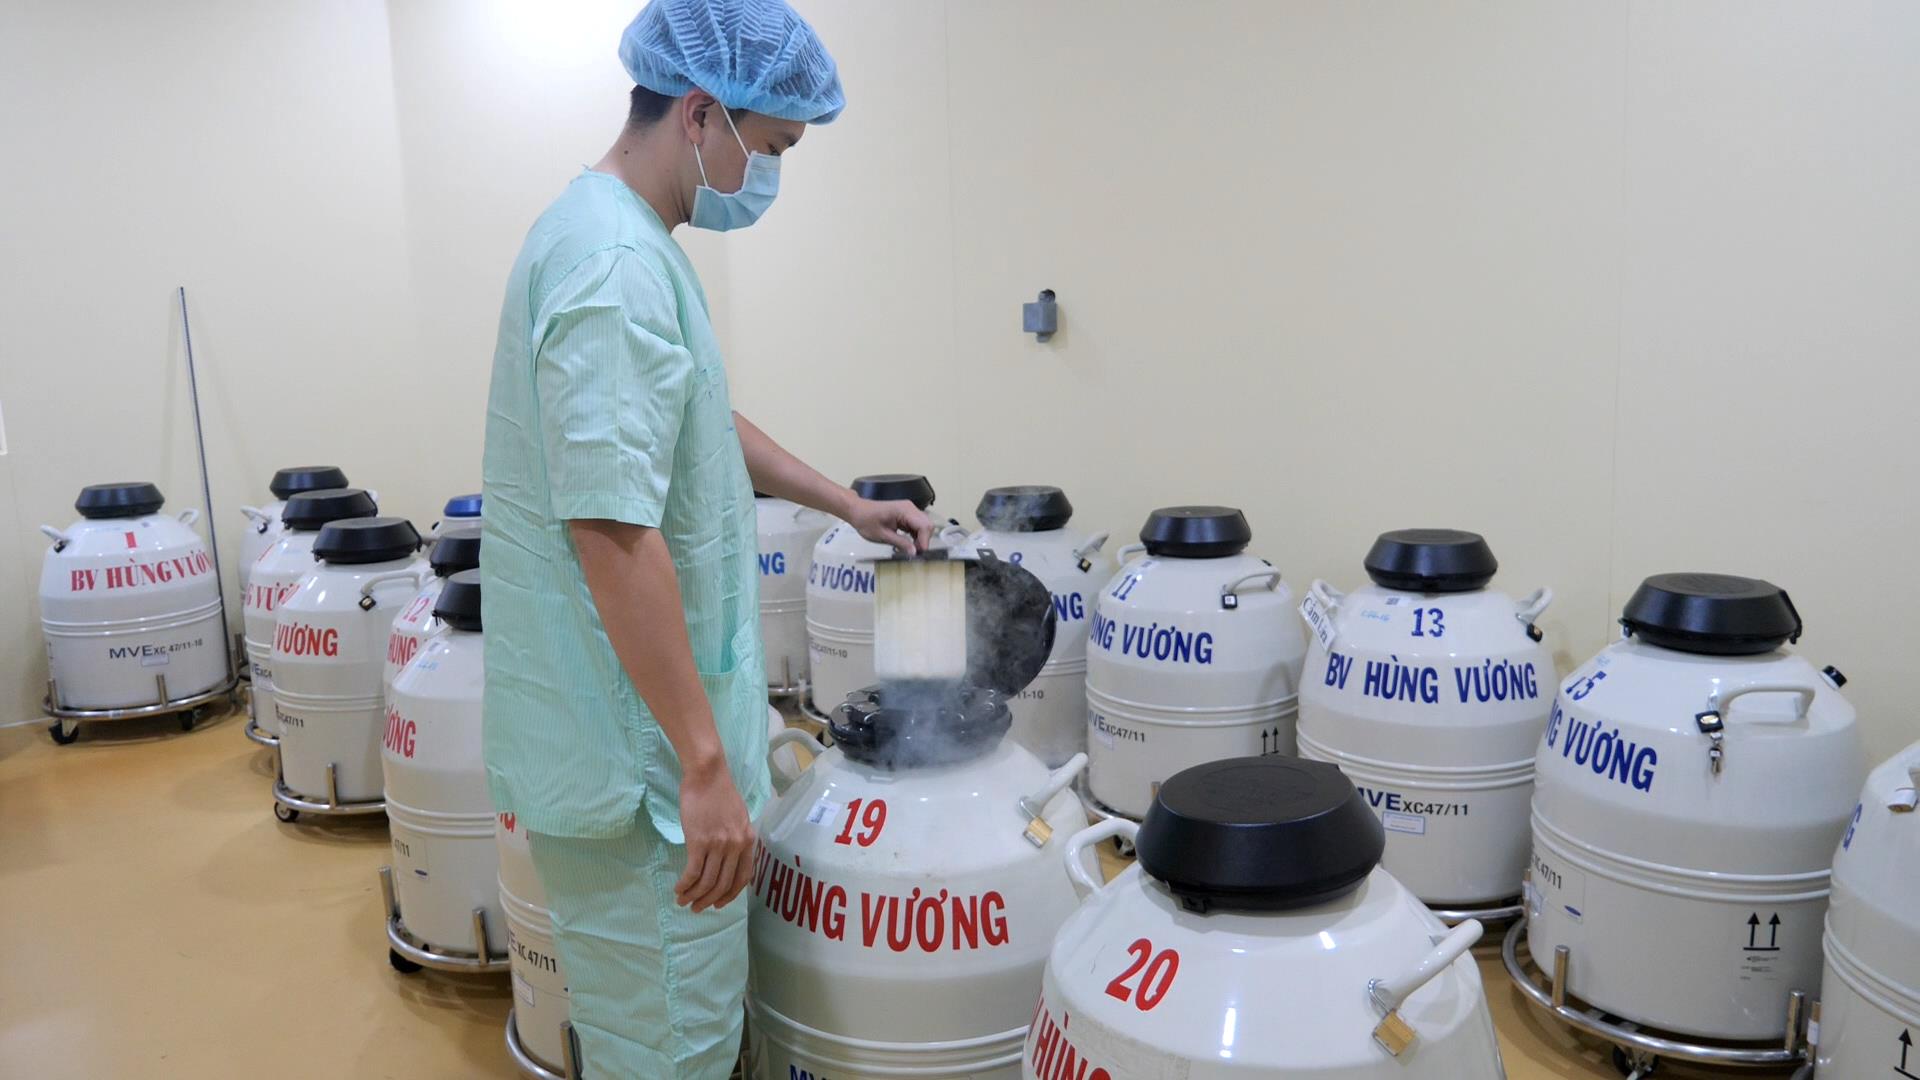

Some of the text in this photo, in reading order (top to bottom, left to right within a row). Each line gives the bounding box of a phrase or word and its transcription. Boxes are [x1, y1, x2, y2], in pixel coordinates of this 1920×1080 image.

[71, 569, 98, 592] BV
[105, 558, 172, 590] HÙNG
[1111, 574, 1138, 601] 11
[276, 621, 340, 657] VƯƠNG
[1122, 622, 1214, 665] VƯƠNG
[1411, 607, 1446, 637] 13
[1324, 652, 1538, 703] BV HÙNG VƯƠNG
[1563, 717, 1658, 794] VƯƠNG
[834, 797, 887, 848] 19
[765, 854, 847, 942] HÙNG
[860, 886, 1010, 953] VƯƠNG
[1104, 937, 1181, 1013] 20
